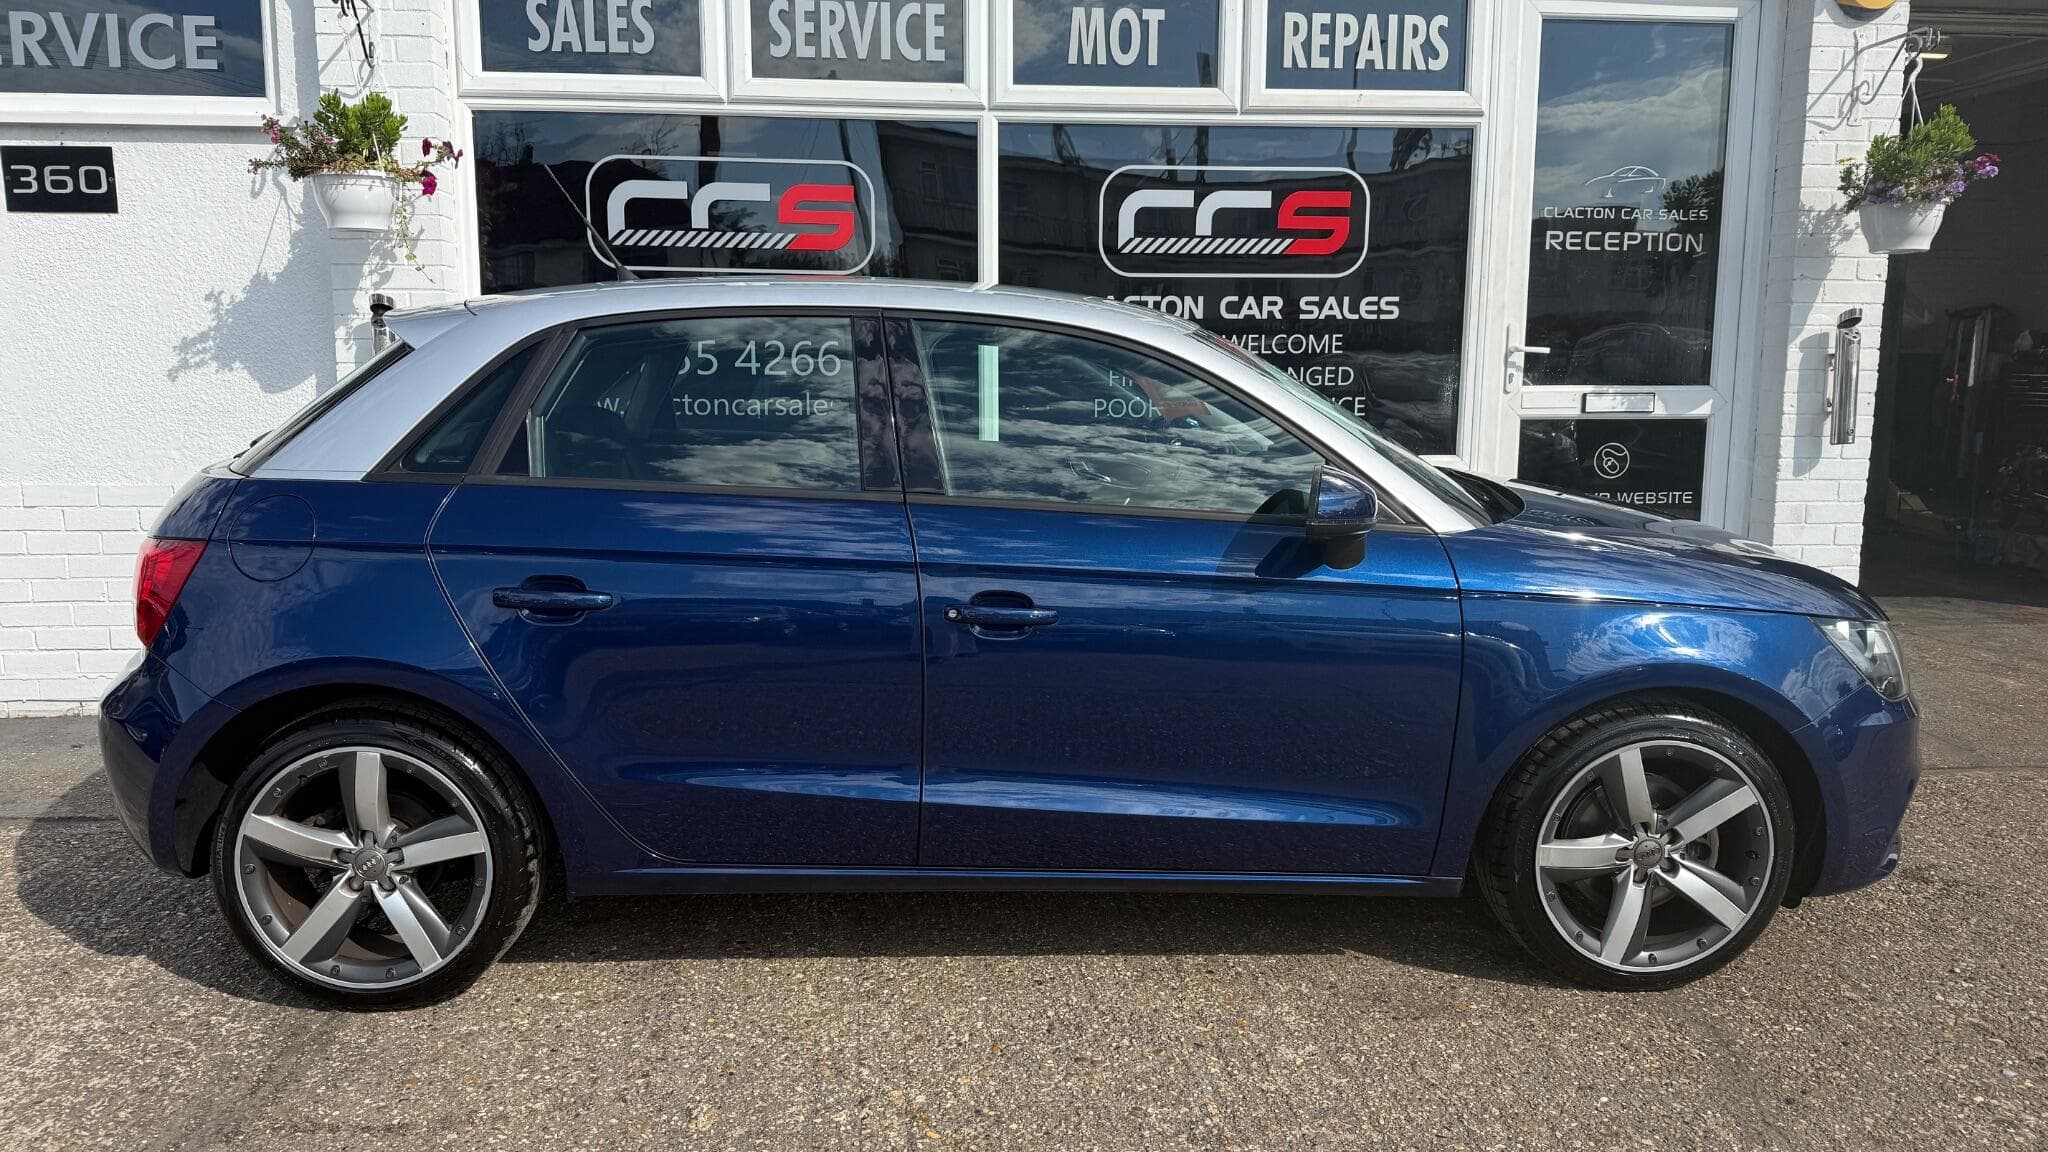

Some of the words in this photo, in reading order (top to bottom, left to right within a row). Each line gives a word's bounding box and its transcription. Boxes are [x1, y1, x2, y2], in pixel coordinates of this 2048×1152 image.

[0, 11, 218, 70] RVICE
[526, 0, 655, 54] SALES
[769, 0, 946, 62] SERVICE
[1068, 7, 1165, 66] MOT
[1283, 12, 1449, 71] REPAIRS
[10, 165, 108, 194] 360
[1544, 206, 1615, 219] CLACTON
[1621, 208, 1652, 220] CAR
[1659, 209, 1709, 221] SALES
[1545, 230, 1704, 252] RECEPTION
[1219, 296, 1283, 319] CAR
[1299, 296, 1400, 319] SALES
[734, 340, 841, 376] 4266
[1617, 492, 1693, 504] WEBSITE
